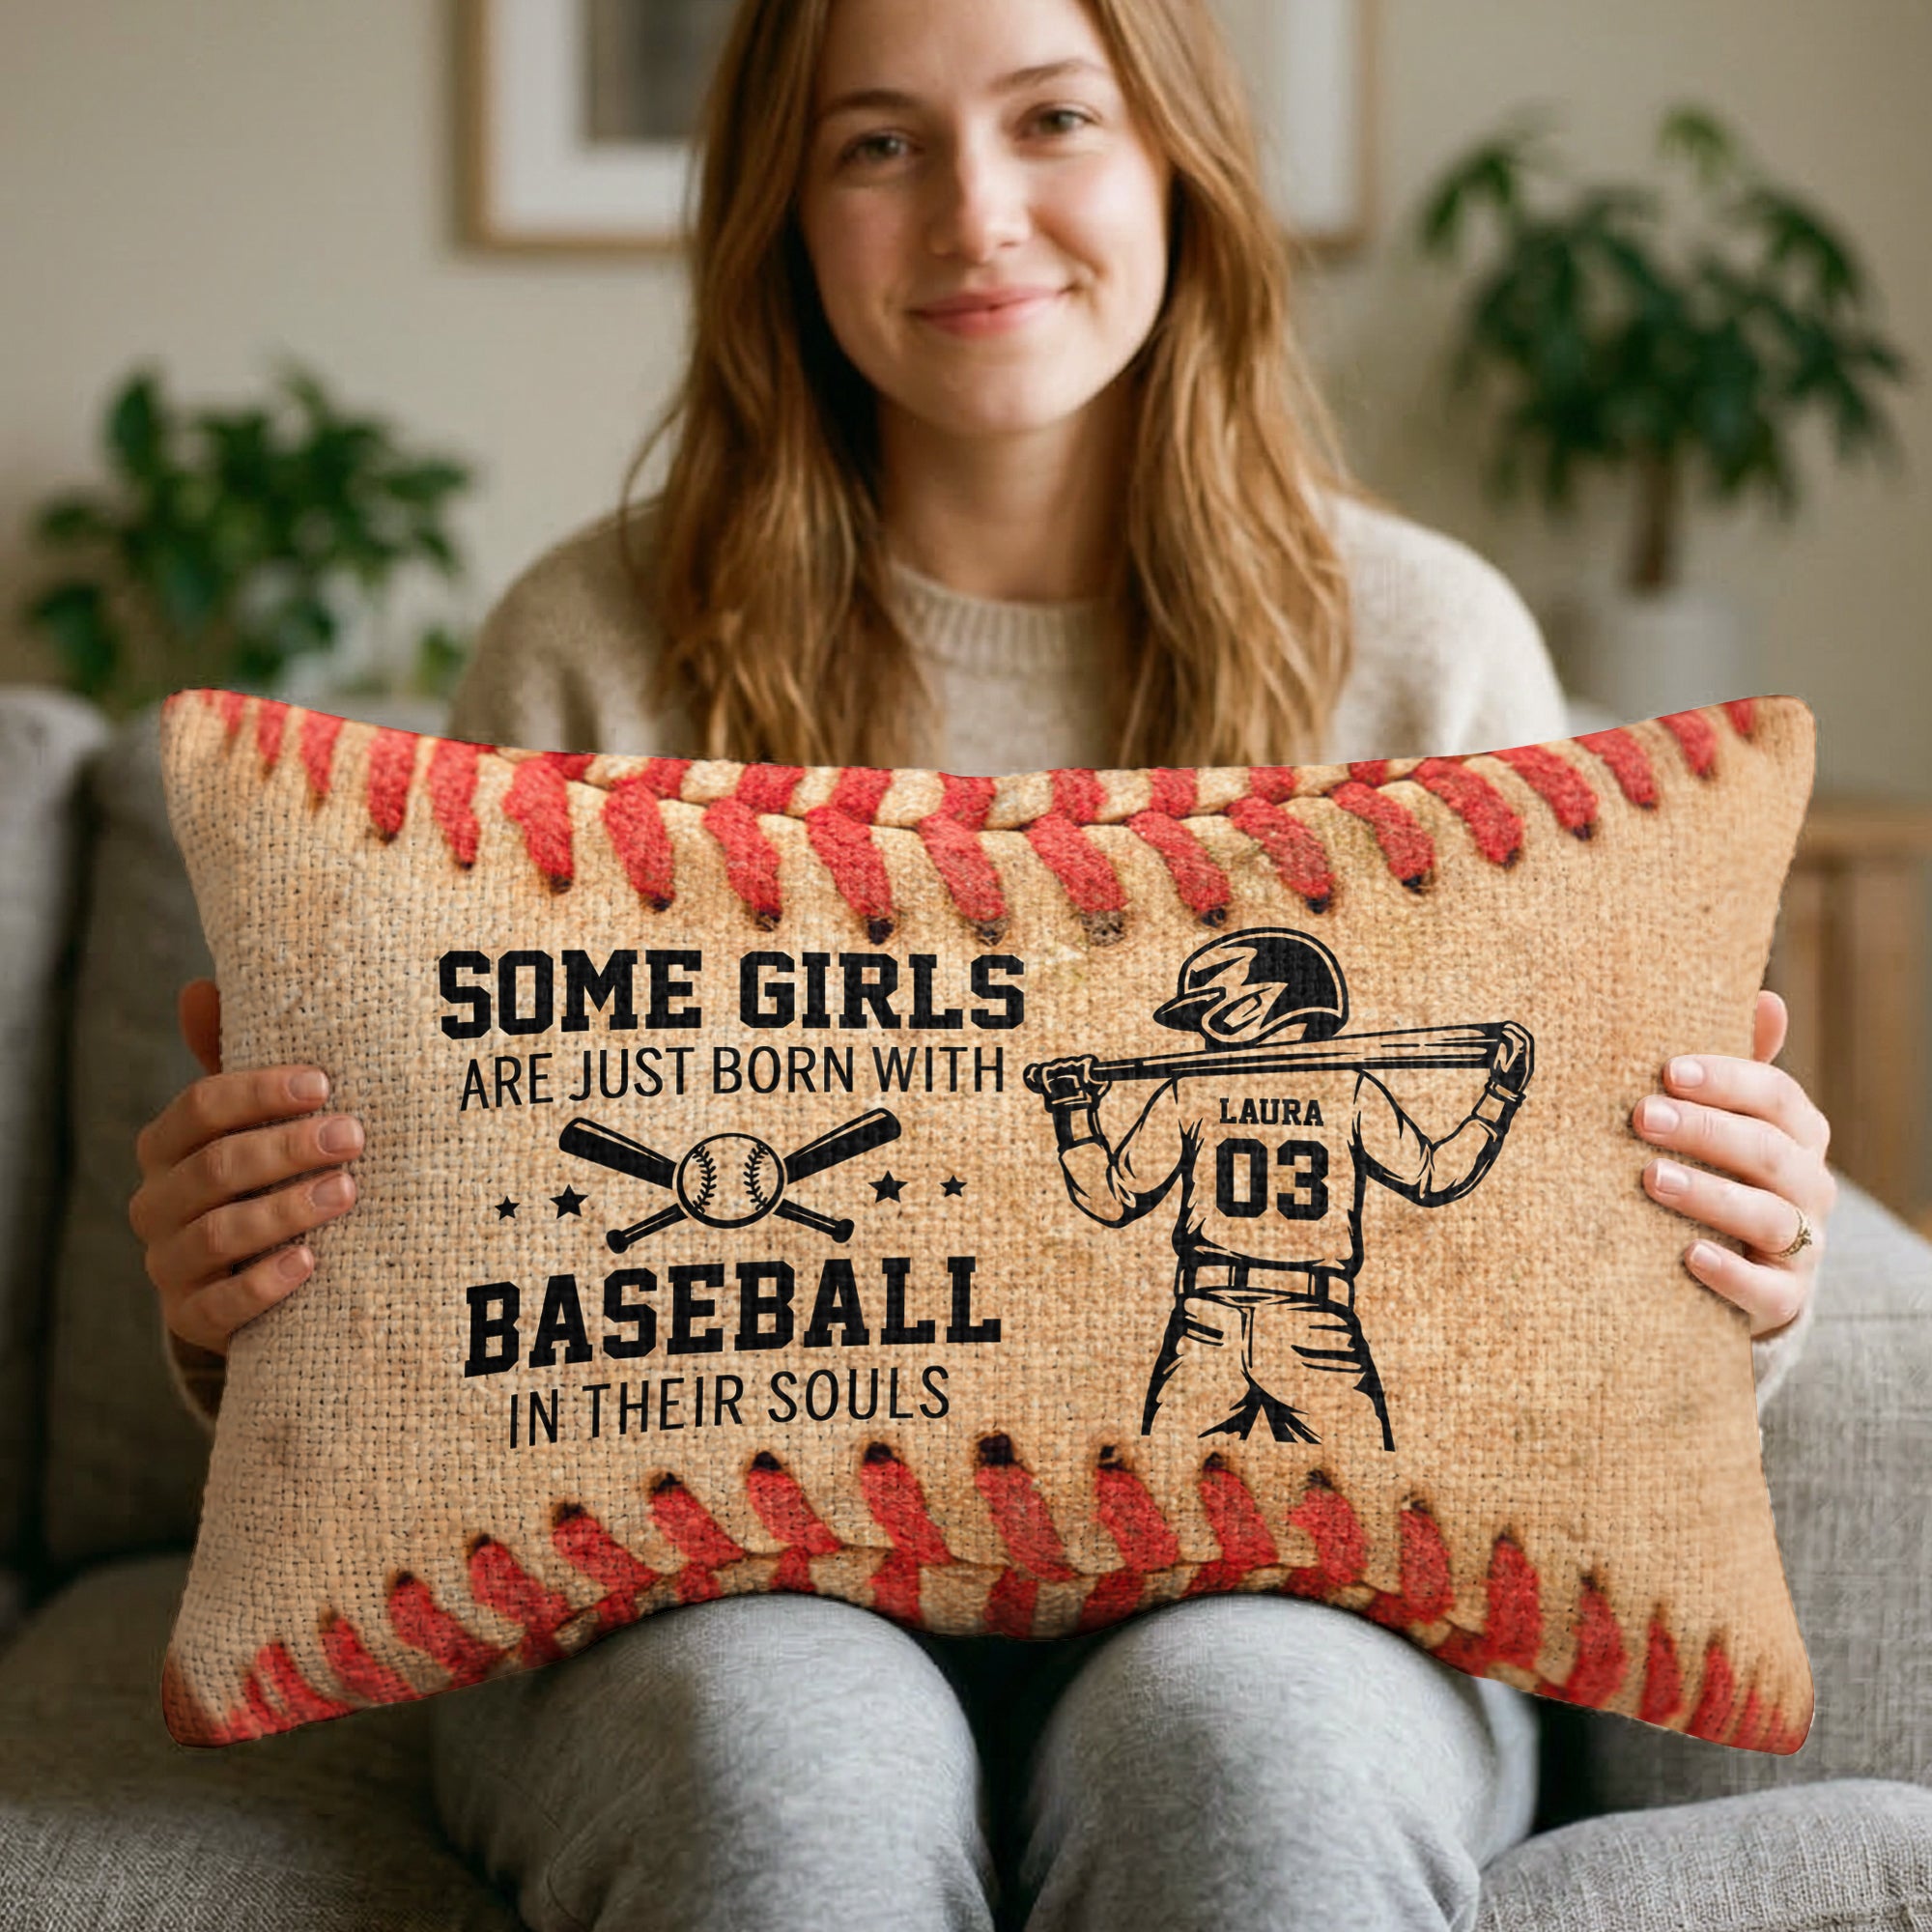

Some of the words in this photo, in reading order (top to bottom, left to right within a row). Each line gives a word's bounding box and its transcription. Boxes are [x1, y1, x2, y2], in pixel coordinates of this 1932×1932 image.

[439, 949, 702, 1040] SOME
[739, 951, 1025, 1030] GIRLS
[460, 1052, 554, 1112] ARE
[568, 1046, 695, 1101] JUST
[713, 1045, 853, 1094] BORN
[871, 1046, 1004, 1093] WITH
[1219, 1097, 1324, 1127] LAURA
[1215, 1137, 1329, 1221] 03
[464, 1256, 1002, 1378] BASEBALL
[509, 1388, 558, 1449] IN
[582, 1374, 744, 1438] THEIR
[767, 1365, 950, 1423] SOULS
